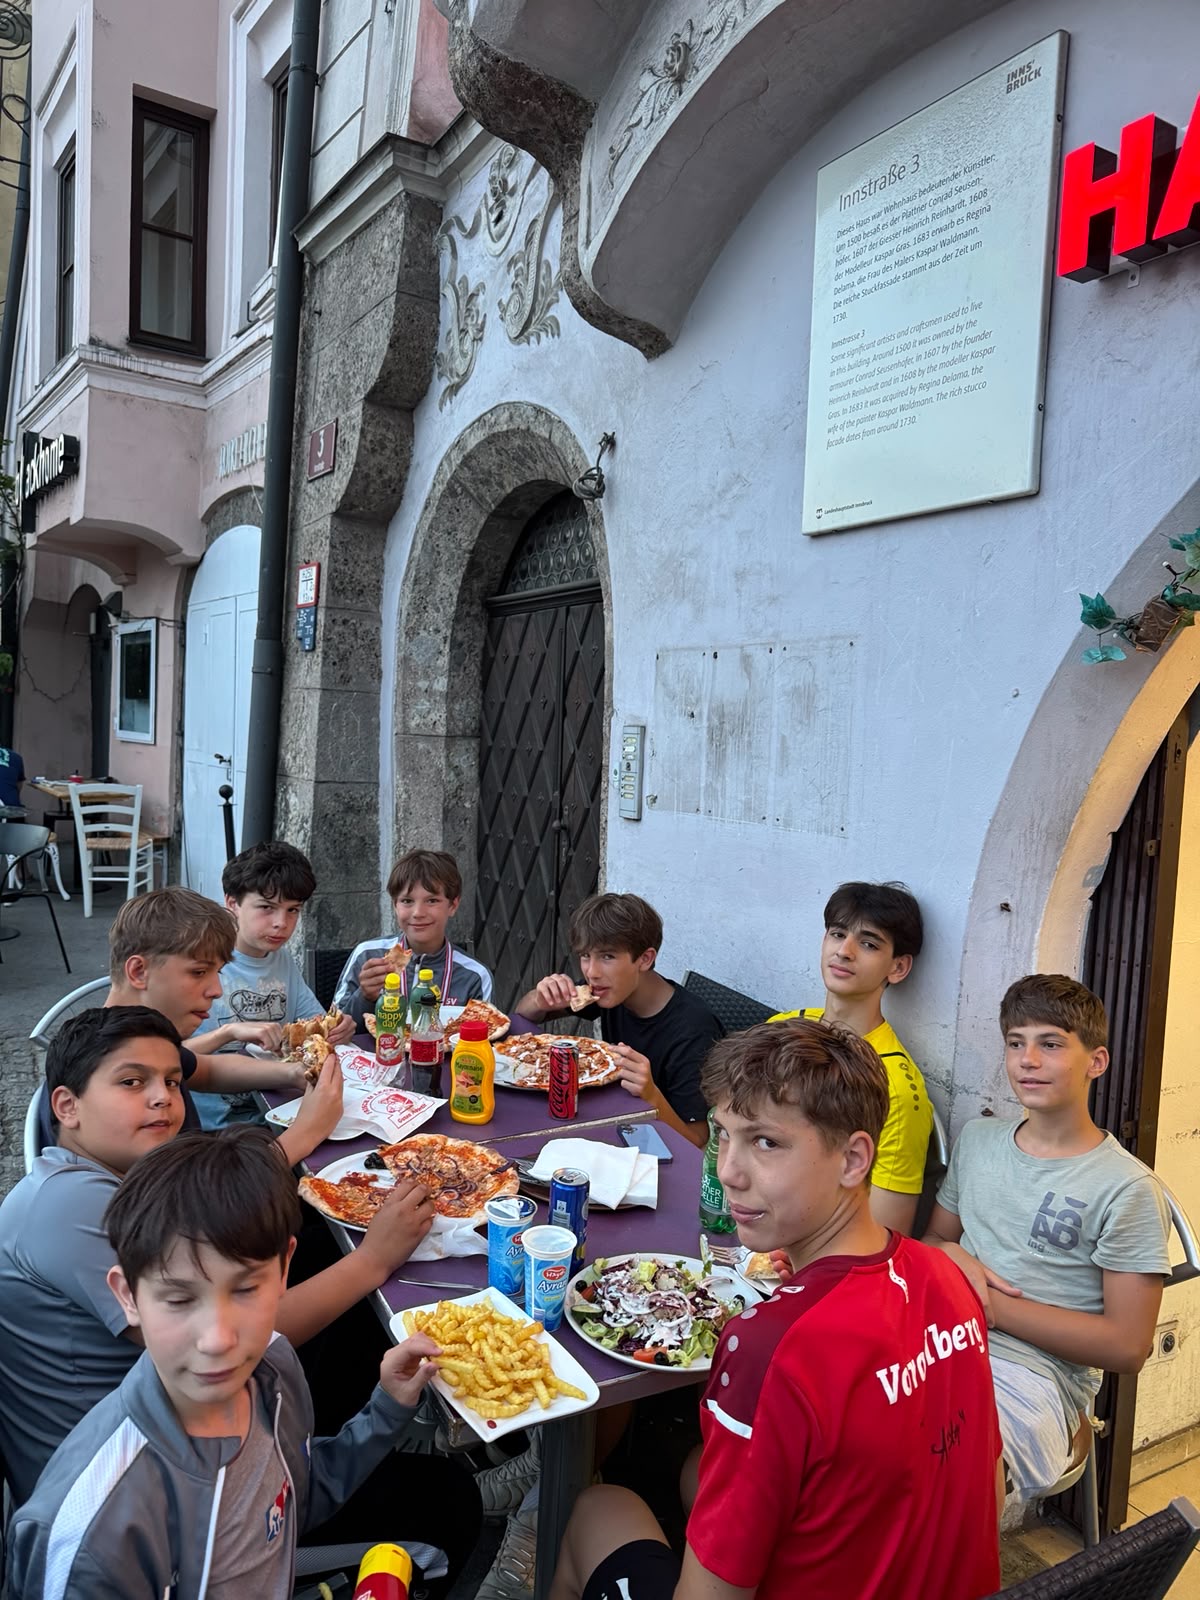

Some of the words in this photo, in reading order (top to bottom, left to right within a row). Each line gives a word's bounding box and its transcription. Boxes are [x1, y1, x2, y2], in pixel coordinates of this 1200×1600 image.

[1006, 67, 1041, 93] BRUCK
[836, 224, 854, 238] Dieses
[855, 216, 870, 228] Haus
[871, 210, 882, 220] war
[883, 192, 917, 214] Wohnhaus
[918, 170, 961, 197] bedeutender
[838, 164, 906, 210] Innstraße
[909, 153, 920, 174] 3
[834, 271, 843, 281] der
[873, 248, 894, 262] Kaspar
[912, 230, 929, 245] 1683
[931, 219, 955, 236] erwarb
[956, 216, 964, 225] es
[965, 204, 991, 221] Regina
[847, 233, 861, 247] 1500
[862, 223, 880, 239] besaß
[881, 221, 888, 230] es
[889, 215, 900, 226] der
[901, 202, 927, 220] Plattner
[928, 187, 952, 207] Conrad
[852, 244, 867, 259] 1607
[868, 241, 878, 251] der
[878, 230, 901, 245] Giesser
[902, 215, 929, 234] Heinrich
[968, 188, 988, 204] 1608
[832, 300, 842, 309] Die
[861, 275, 900, 297] Stuckfassade
[901, 263, 927, 280] stammt
[928, 258, 940, 269] aus
[941, 252, 953, 263] der
[954, 245, 968, 257] Zeit
[969, 240, 982, 251] um
[867, 269, 881, 280] Frau
[881, 263, 892, 273] des
[893, 254, 914, 268] Malers
[916, 243, 938, 258] Kaspar
[830, 352, 845, 363] Some
[846, 340, 875, 358] significant
[876, 333, 895, 345] artists
[896, 326, 908, 338] and
[909, 316, 942, 333] craftsmen
[943, 307, 960, 321] used
[960, 306, 969, 315] to
[969, 301, 983, 311] live
[831, 332, 860, 348] Innstrasse
[860, 329, 865, 337] 3
[835, 366, 846, 375] this
[871, 346, 894, 362] Around
[894, 341, 911, 354] 1500
[918, 335, 931, 345] was
[932, 325, 955, 341] owned
[955, 323, 965, 334] by
[965, 319, 978, 329] the
[854, 367, 876, 382] Conrad
[923, 346, 941, 359] 1607
[941, 344, 950, 354] by
[951, 340, 963, 350] the
[963, 330, 993, 348] founder
[828, 391, 851, 405] Heinrich
[851, 382, 879, 397] Reinhardt
[879, 376, 892, 388] and
[899, 369, 917, 382] 1608
[917, 367, 926, 377] by
[926, 363, 937, 373] the
[938, 353, 969, 369] modeller
[969, 345, 996, 359] Kaspar
[848, 401, 863, 413] 1683
[869, 397, 881, 406] was
[881, 386, 909, 402] acquired
[909, 384, 918, 395] by
[918, 378, 940, 391] Regina
[971, 365, 983, 375] the
[838, 420, 845, 431] of
[845, 419, 855, 428] the
[855, 413, 877, 427] painter
[877, 406, 898, 418] Kaspar
[936, 391, 948, 401] The
[949, 386, 962, 397] rich
[963, 380, 987, 393] stucco
[317, 429, 325, 459] 3
[826, 436, 844, 450] facade
[845, 432, 860, 442] dates
[861, 428, 876, 440] from
[876, 419, 898, 433] around
[377, 1009, 404, 1022] happy
[382, 1020, 399, 1030] day
[507, 1246, 525, 1257] Ayr
